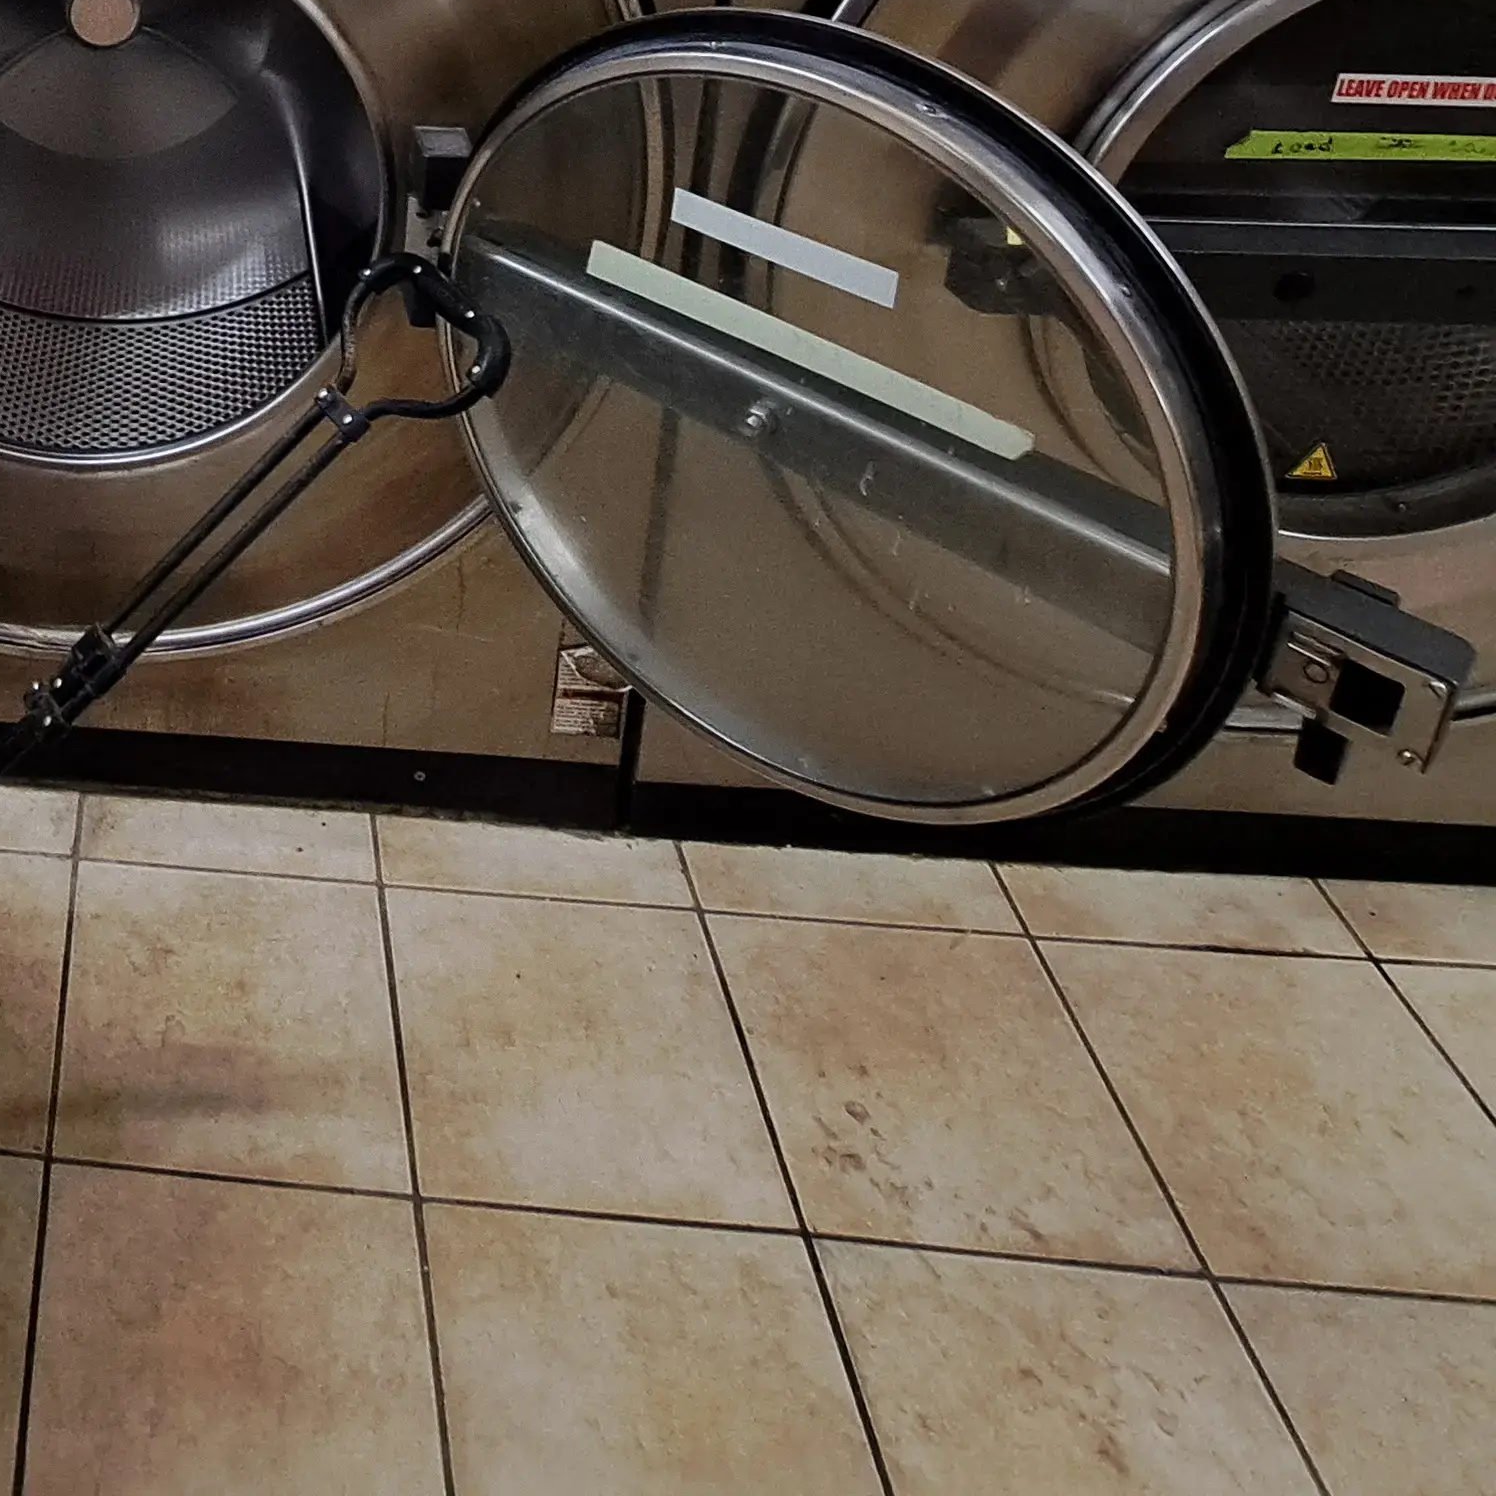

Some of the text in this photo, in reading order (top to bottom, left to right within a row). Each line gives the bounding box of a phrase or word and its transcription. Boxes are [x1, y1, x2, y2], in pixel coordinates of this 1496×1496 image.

[1337, 79, 1386, 98] LEAVE
[1387, 81, 1426, 99] OPEN
[1431, 82, 1479, 100] WHEN
